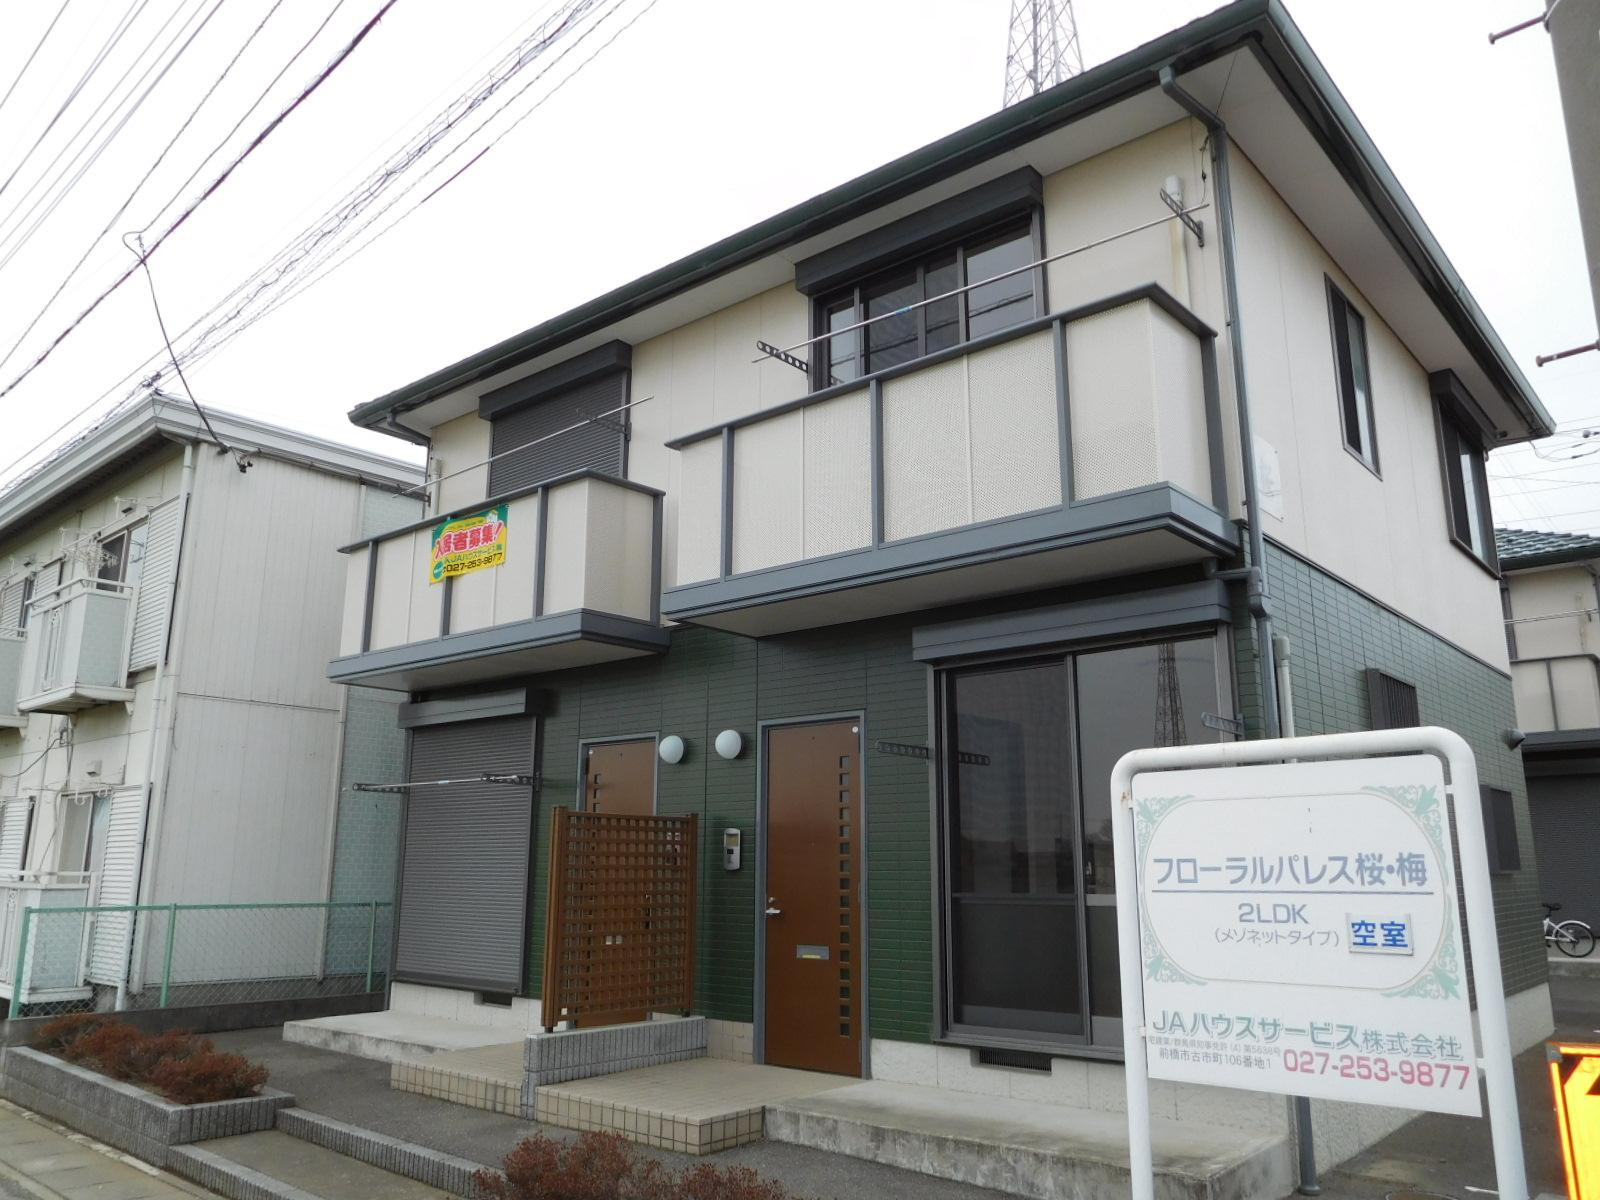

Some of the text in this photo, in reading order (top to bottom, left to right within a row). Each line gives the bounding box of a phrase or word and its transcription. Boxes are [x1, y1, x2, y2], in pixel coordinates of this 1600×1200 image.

[446, 552, 503, 573] 027-253-9877
[1152, 852, 1428, 887] フローラルパレス桜・梅
[1238, 902, 1310, 925] 2LDK
[1351, 920, 1408, 949] 空室
[1153, 1010, 1464, 1061] JAハウスサービス株式会社
[1159, 1047, 1271, 1070] 前橋市古市町106番地1
[1283, 1048, 1470, 1090] 027-253-9877
